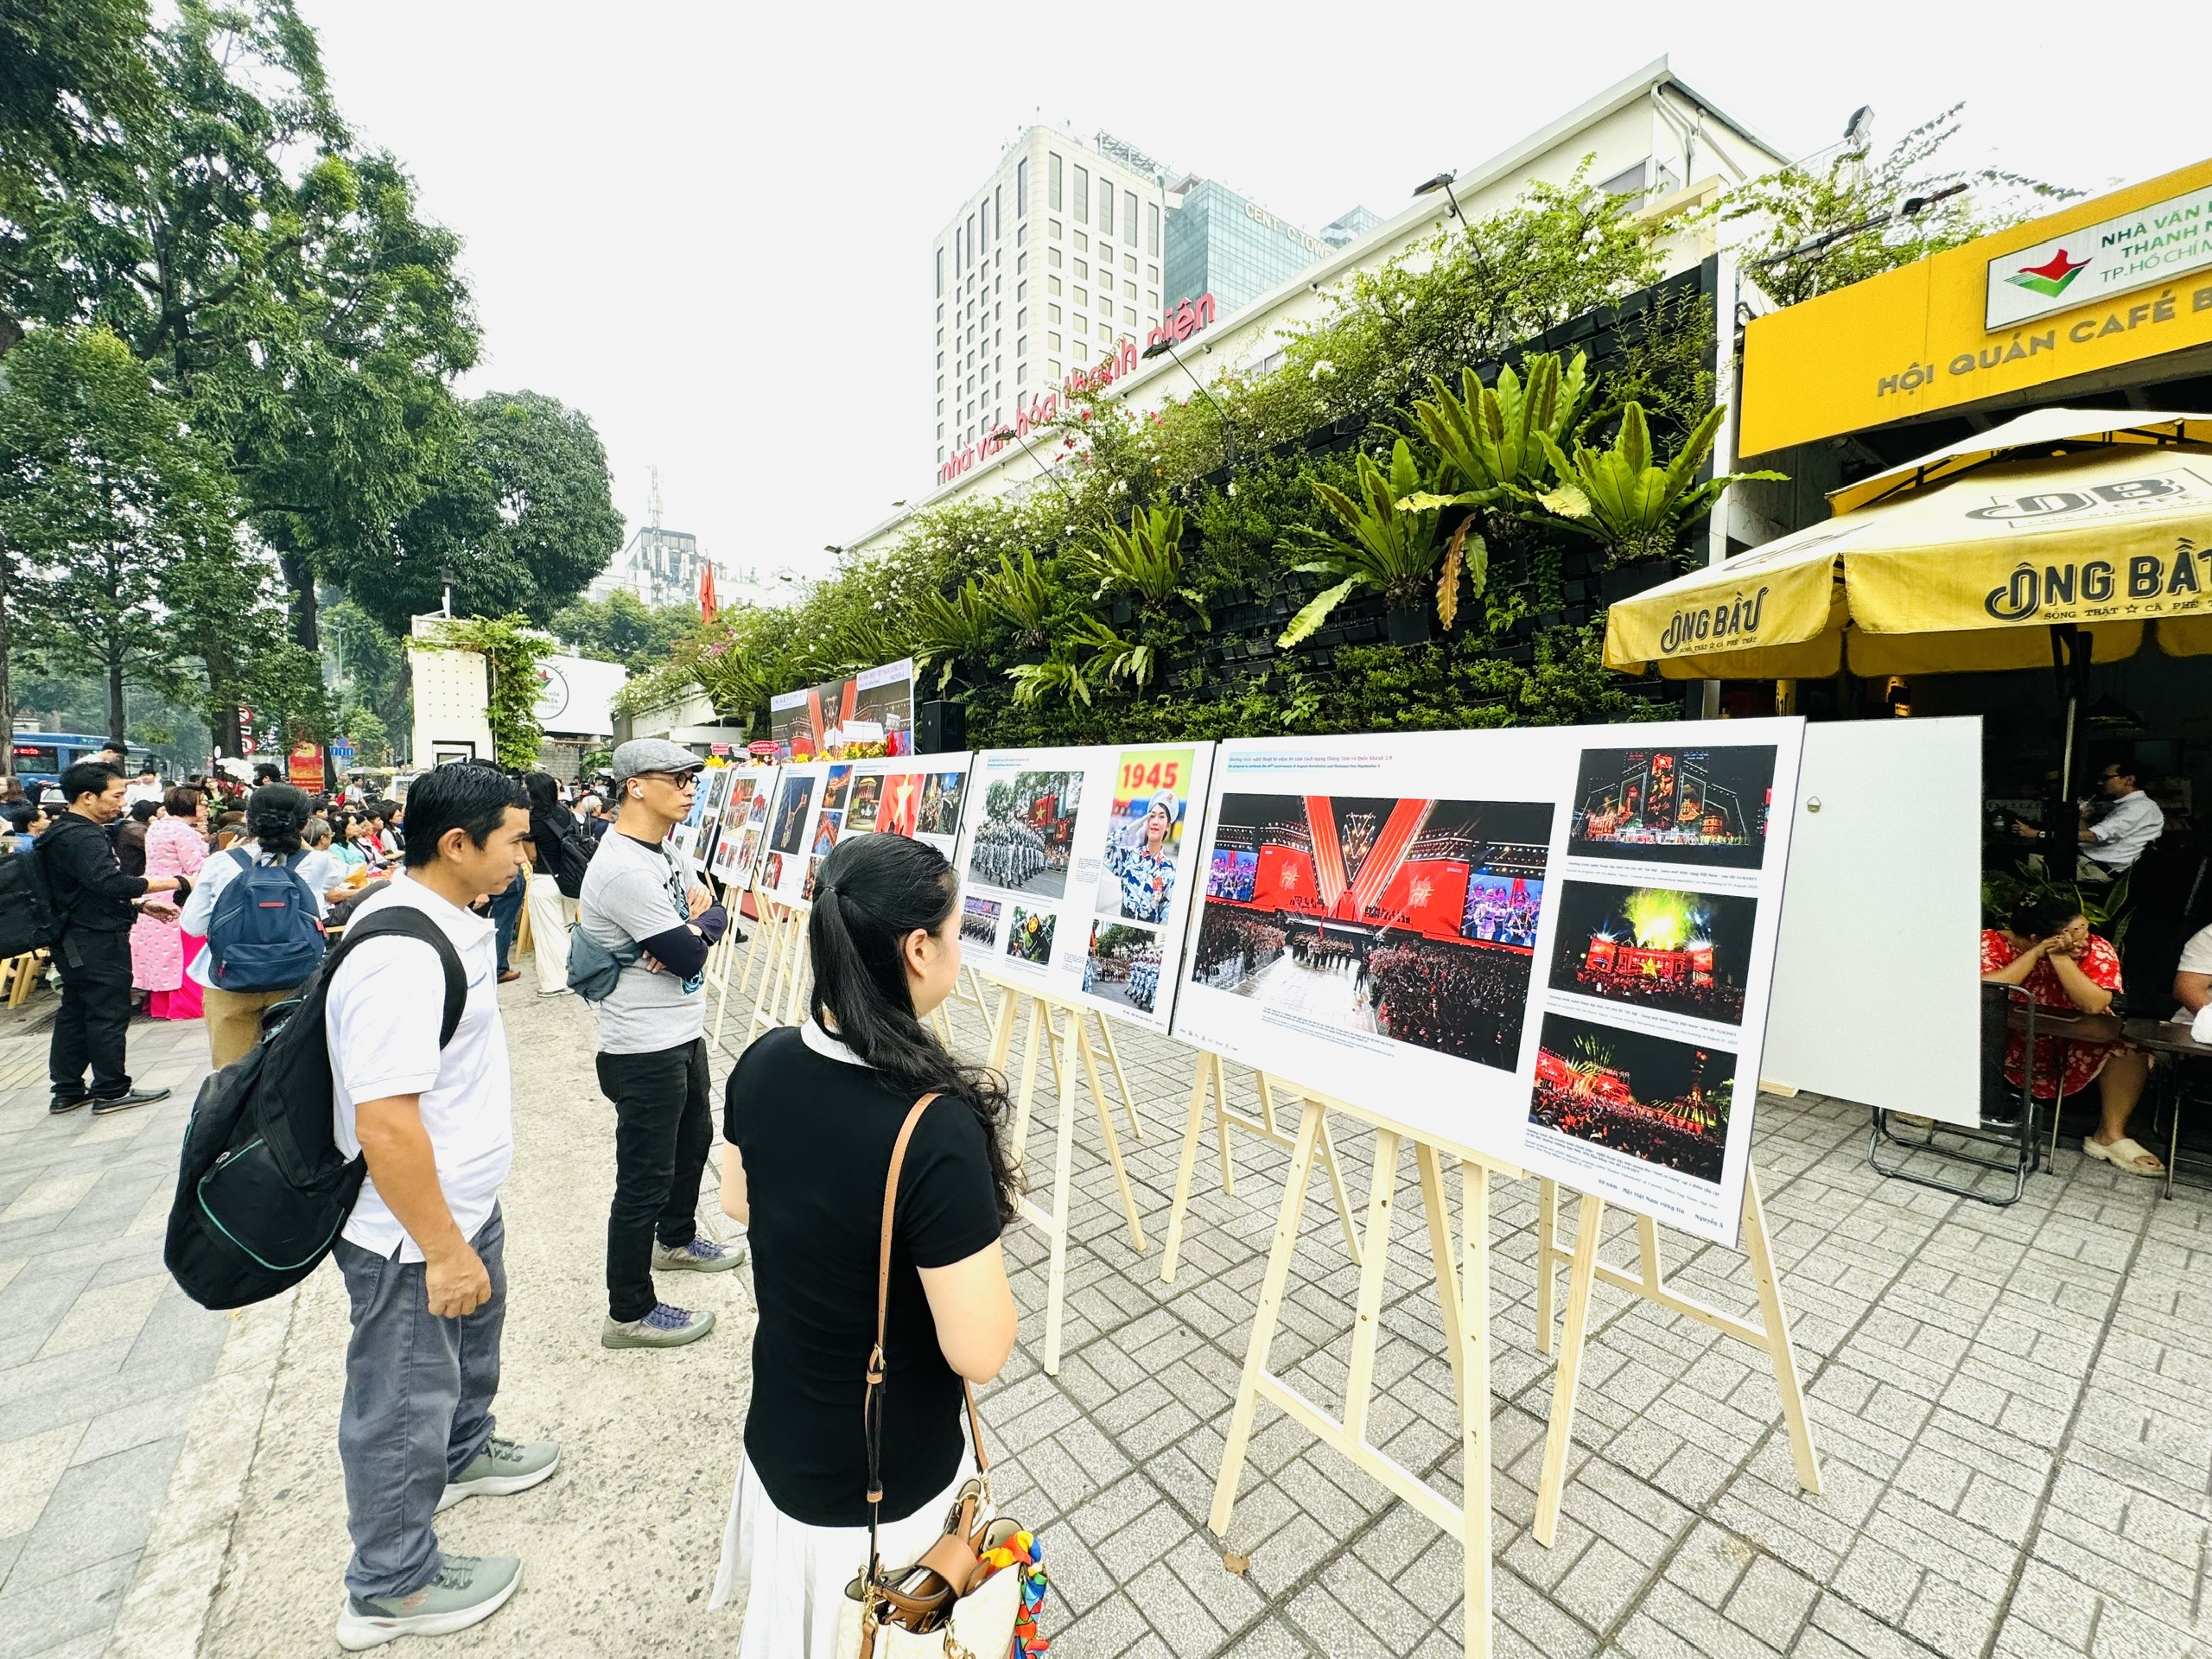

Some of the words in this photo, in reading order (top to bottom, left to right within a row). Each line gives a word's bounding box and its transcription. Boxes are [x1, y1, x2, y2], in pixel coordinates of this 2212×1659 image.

[2154, 205, 2200, 230] VĂN
[1299, 231, 1337, 258] TOWE
[2121, 225, 2198, 258] THANH
[1877, 362, 1934, 397] HỘI
[1948, 330, 2055, 376] QUÁN
[2069, 289, 2176, 344] CAFÉ
[941, 442, 975, 484] nhà
[1016, 393, 1057, 438] hóa
[1985, 562, 2114, 622] ÔNG
[1661, 609, 1711, 655] ÔNG
[1712, 586, 1770, 639] BẦU
[1123, 761, 1179, 790] 1945
